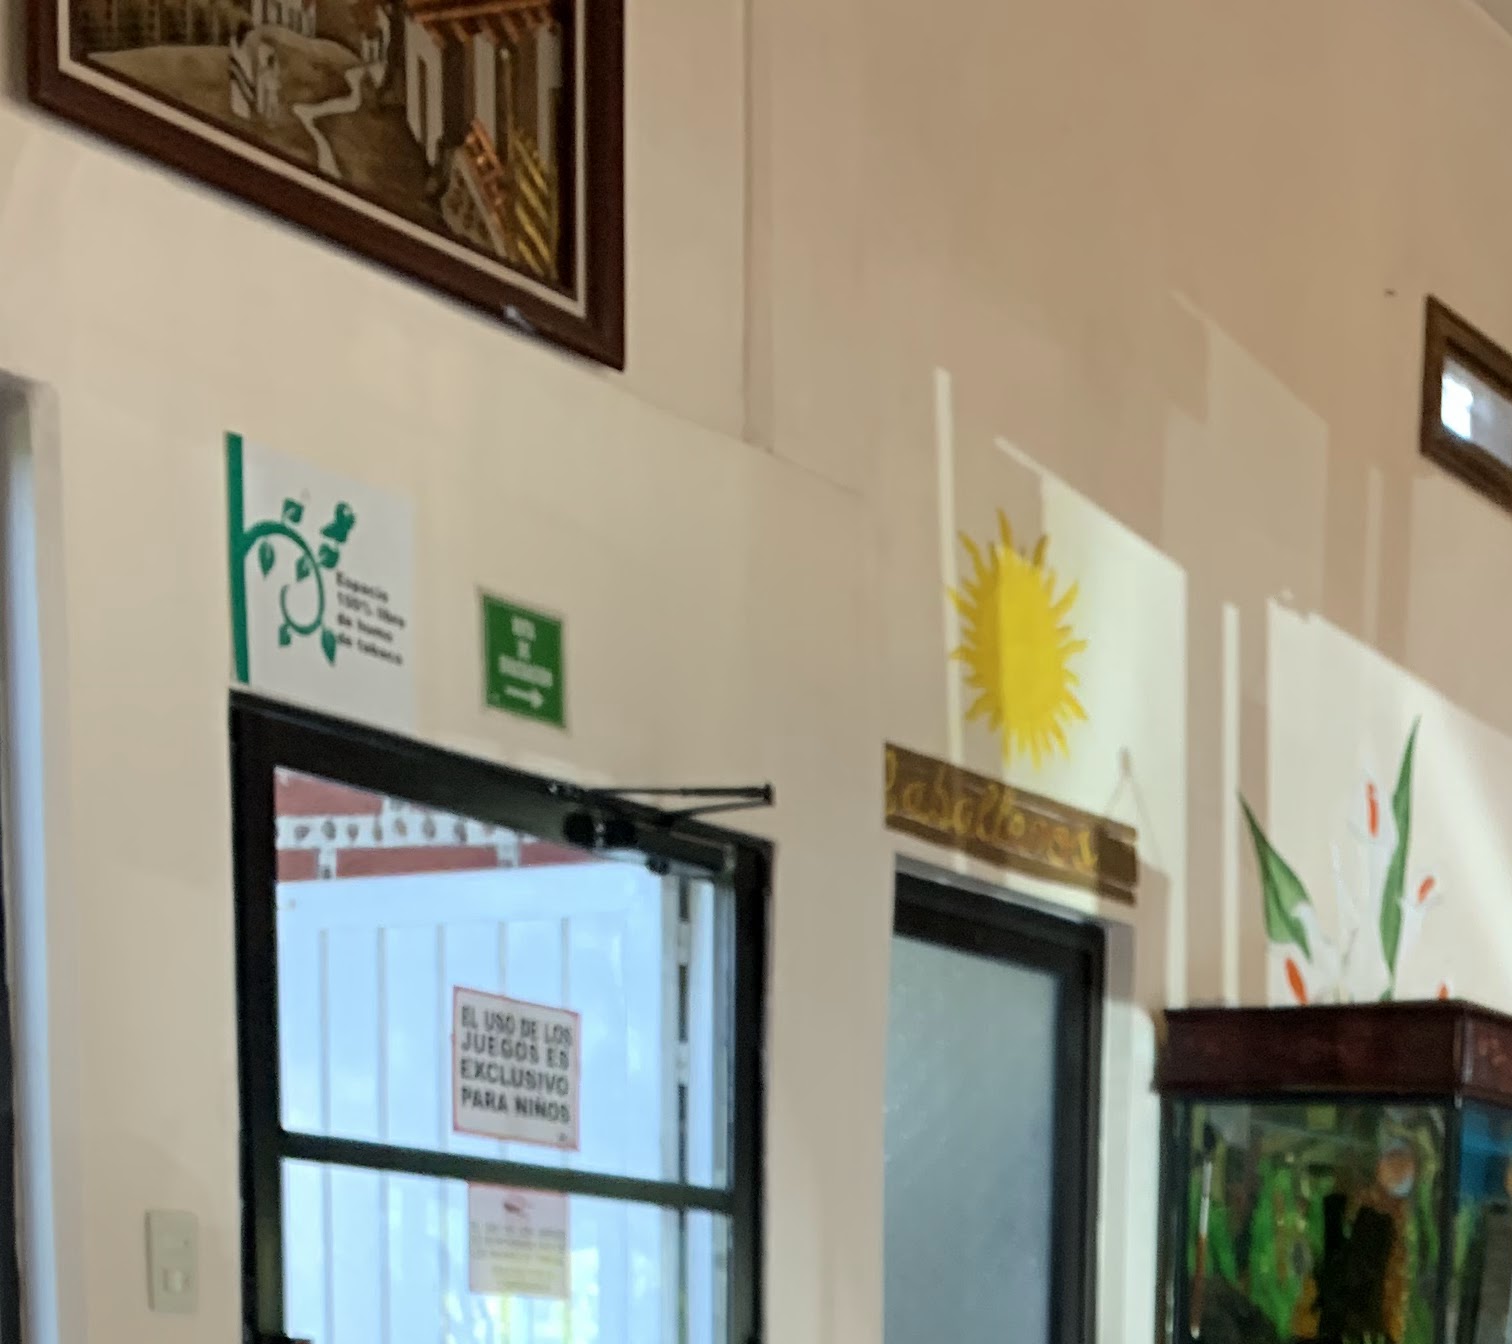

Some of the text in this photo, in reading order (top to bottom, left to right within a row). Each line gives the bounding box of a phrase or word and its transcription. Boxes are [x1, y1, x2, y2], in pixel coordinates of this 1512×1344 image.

[461, 1005, 573, 1046] EL USO DE LOS
[461, 1031, 570, 1071] JUEGOS ES
[461, 1058, 569, 1097] EXCLUSIVO
[461, 1085, 508, 1114] PARA
